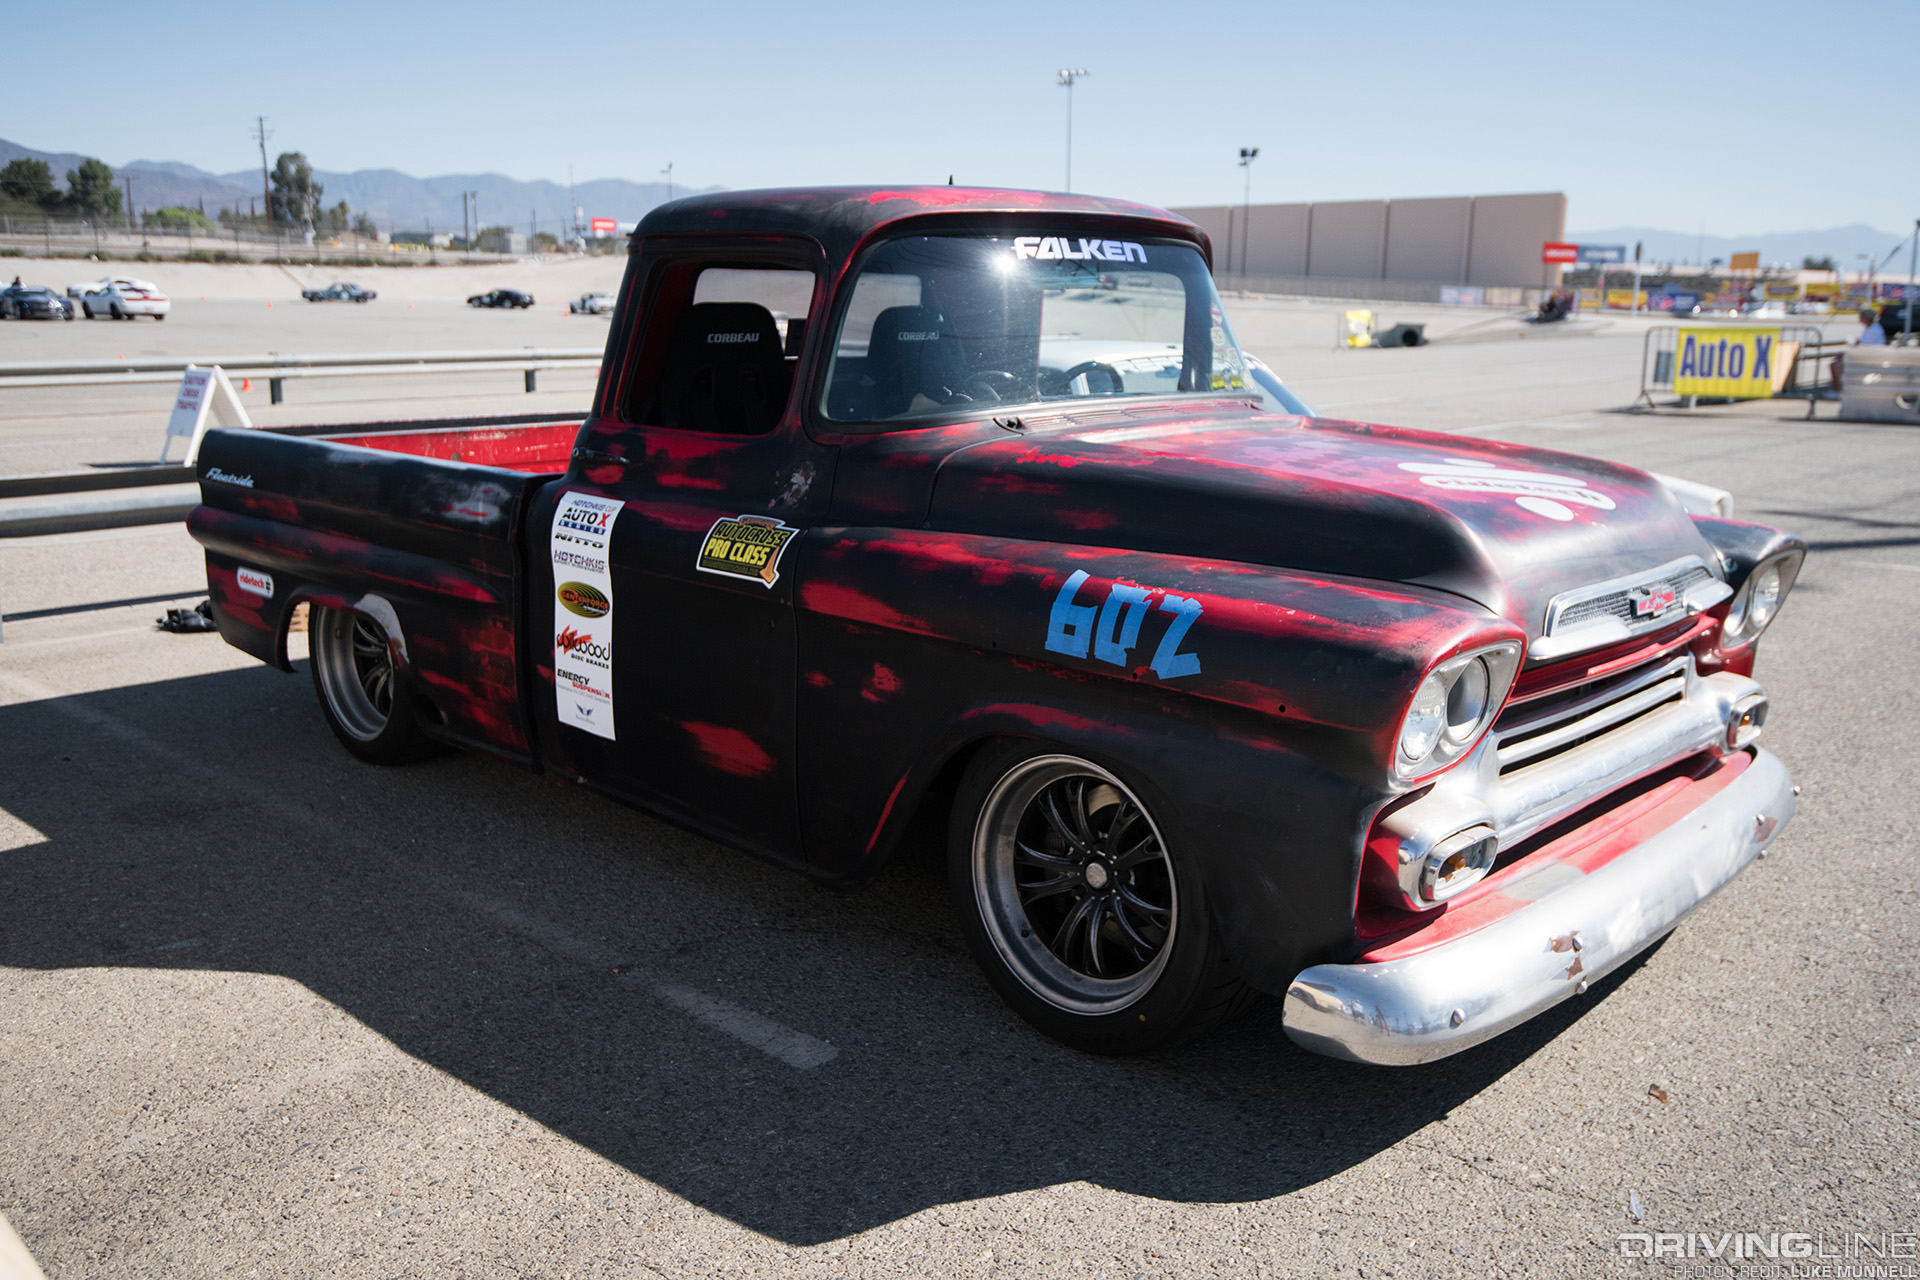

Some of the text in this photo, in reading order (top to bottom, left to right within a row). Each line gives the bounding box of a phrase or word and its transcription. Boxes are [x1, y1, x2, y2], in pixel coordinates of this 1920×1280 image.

[1011, 237, 1148, 263] FALKEN
[707, 332, 760, 344] CORBEAU
[898, 331, 941, 341] CORBEAU
[1680, 334, 1772, 380] Auto X
[562, 507, 599, 525] AUTO
[597, 512, 611, 527] X
[554, 532, 604, 549] NITTO
[712, 521, 791, 547] AUTOCROSS
[554, 550, 605, 571] HOTCHKIS
[704, 537, 771, 566] PRO CLASS
[570, 653, 609, 669] DISC BRAKES
[557, 668, 590, 686] ENERGY
